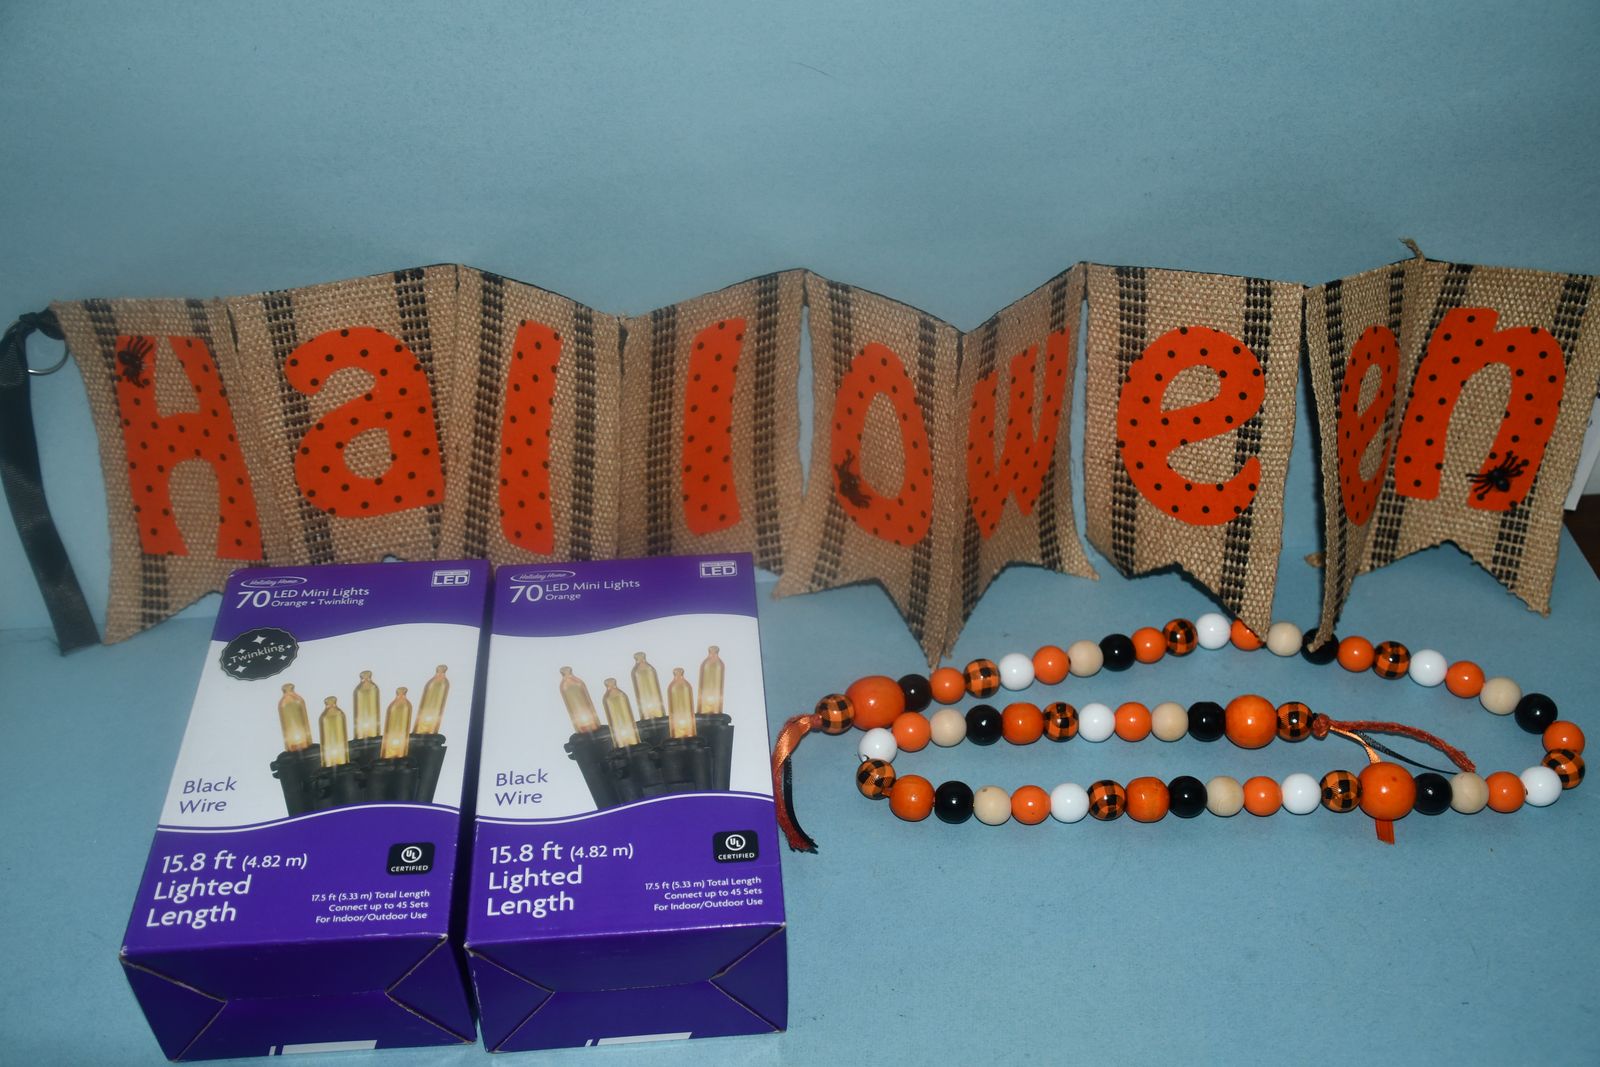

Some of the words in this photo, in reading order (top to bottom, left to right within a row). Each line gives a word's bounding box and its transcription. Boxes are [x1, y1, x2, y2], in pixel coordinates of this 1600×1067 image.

[702, 566, 735, 576] LED
[434, 575, 468, 585] LED
[546, 584, 569, 592] LED
[573, 581, 600, 590] Mini
[604, 580, 640, 590] Lights
[236, 591, 271, 608] 70
[274, 590, 298, 598] LED
[302, 589, 329, 598] Mini
[333, 587, 369, 598] Lights
[509, 584, 543, 603] 70
[318, 597, 364, 606] Twinkling
[230, 643, 285, 664] Twinkling
[496, 769, 548, 786] Black
[183, 777, 237, 794] Black
[179, 799, 227, 813] Wire
[495, 792, 542, 806] Wire
[490, 844, 533, 864] 15.8
[542, 842, 563, 860] ft
[570, 846, 608, 862] (4.82
[612, 844, 634, 859] m)
[718, 852, 754, 860] CERTIFIED
[161, 852, 206, 874] 15.8
[214, 850, 236, 870] ft
[242, 855, 281, 872] (4.82
[286, 853, 308, 870] m)
[489, 865, 582, 894] Lighted
[645, 882, 660, 890] 17.5
[672, 881, 691, 890] (5.33
[693, 880, 704, 888] m)
[731, 876, 761, 887] Length
[154, 875, 251, 903] Lighted
[329, 893, 336, 901] ft
[338, 893, 358, 902] (5.33
[360, 892, 372, 901] m)
[375, 891, 396, 899] Total
[399, 889, 430, 899] Length
[664, 891, 702, 899] Connect
[704, 892, 716, 900] up
[329, 903, 367, 911] Connect
[370, 904, 381, 912] up
[409, 901, 428, 909] Sets
[487, 892, 574, 918] Length
[654, 903, 668, 911] For
[671, 899, 744, 910] Indoor/Outdoor
[146, 902, 236, 929] Length
[316, 915, 330, 923] For
[332, 912, 407, 923] Indoor/Outdoor
[409, 912, 427, 920] Use
